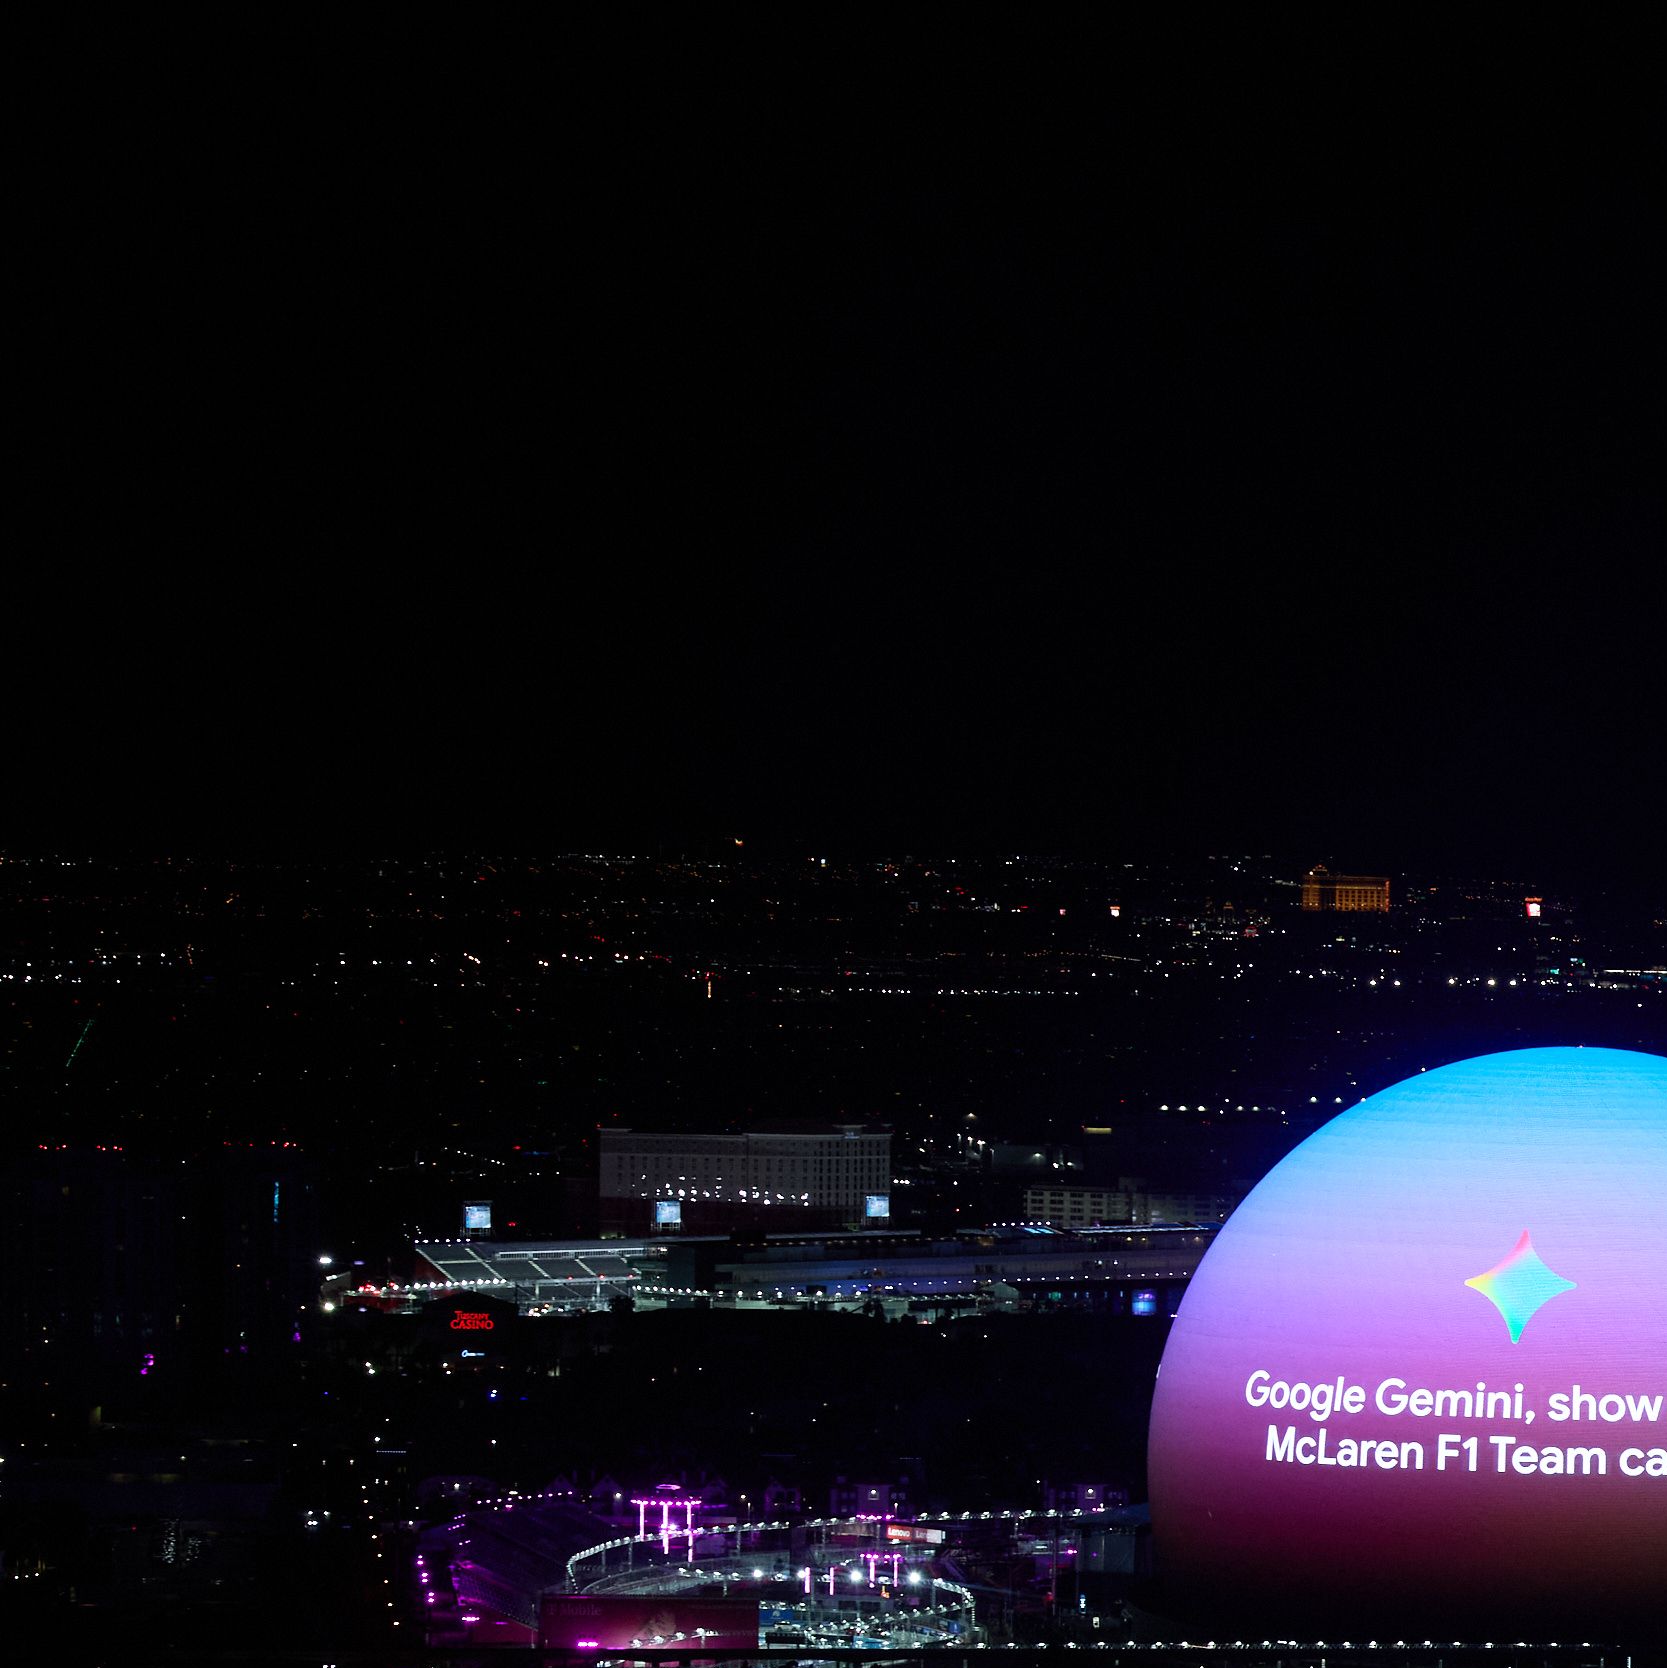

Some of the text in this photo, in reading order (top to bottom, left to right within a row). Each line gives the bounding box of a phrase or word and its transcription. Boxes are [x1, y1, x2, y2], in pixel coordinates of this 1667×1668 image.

[450, 1319, 494, 1330] CASINO
[1245, 1370, 1366, 1422] Google
[1375, 1377, 1536, 1425] Gemini,
[1547, 1384, 1664, 1422] show
[1266, 1424, 1425, 1470] McLaren
[1437, 1434, 1479, 1472] F1
[1489, 1435, 1607, 1476] Team
[887, 1527, 911, 1537] Lenovo
